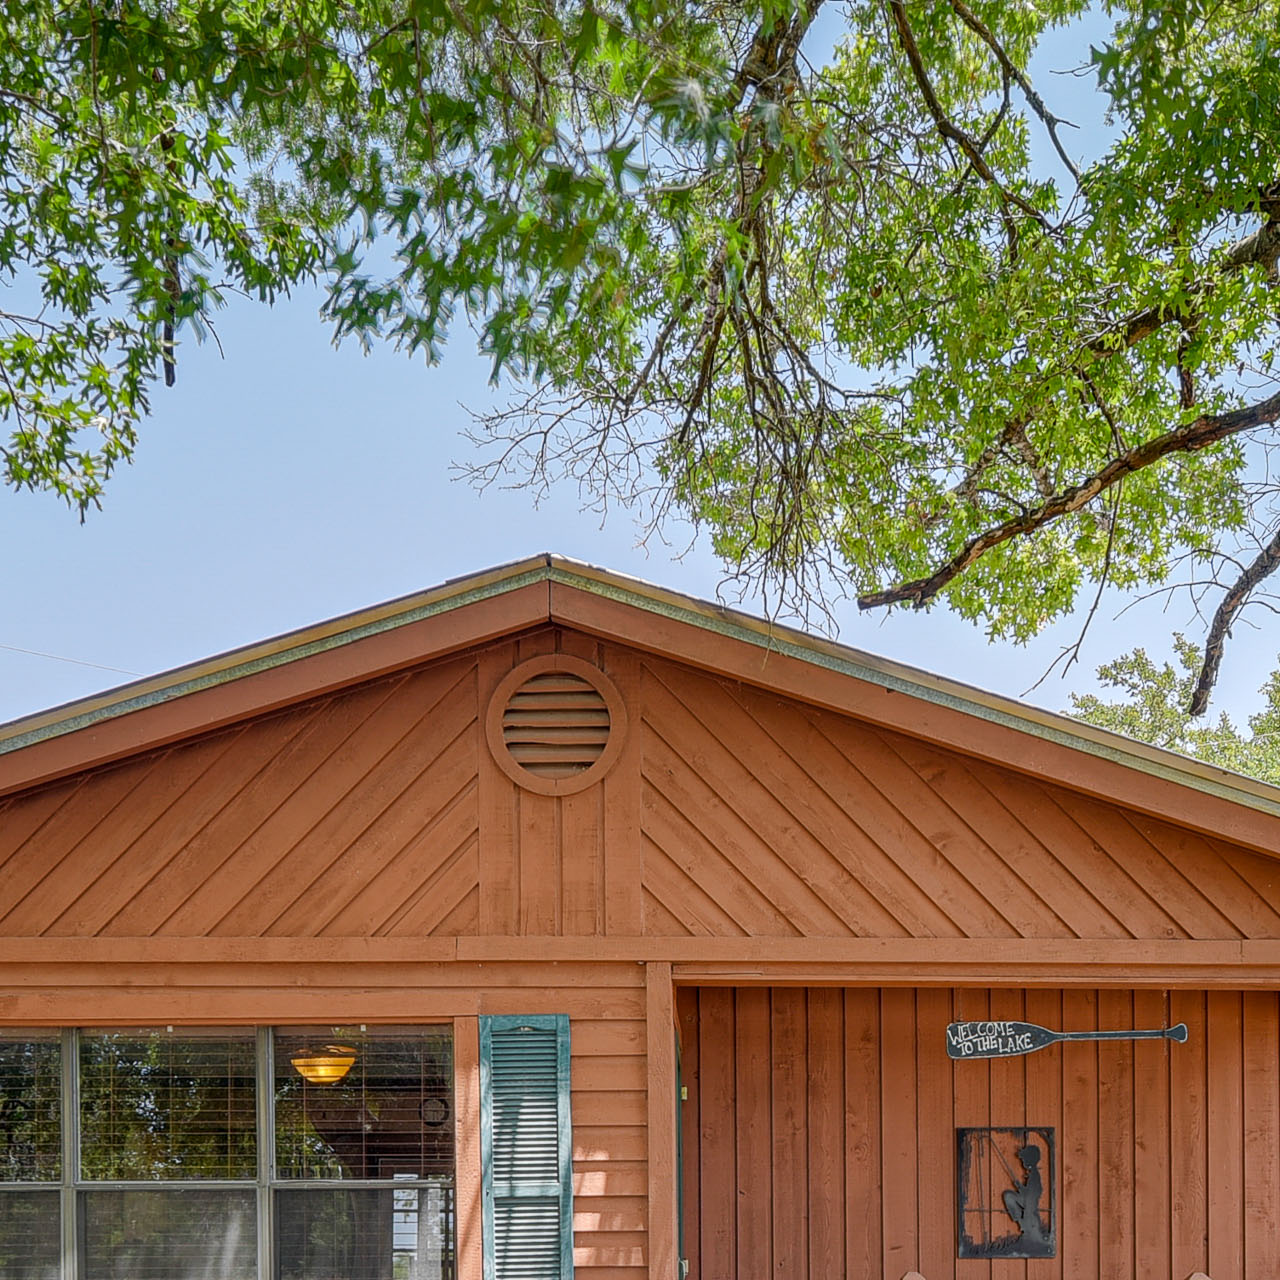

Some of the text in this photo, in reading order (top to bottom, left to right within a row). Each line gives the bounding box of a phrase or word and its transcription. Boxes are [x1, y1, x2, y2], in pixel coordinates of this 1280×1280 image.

[947, 1022, 1015, 1045] WELCOME
[957, 1032, 1033, 1055] TO THE LAKE
